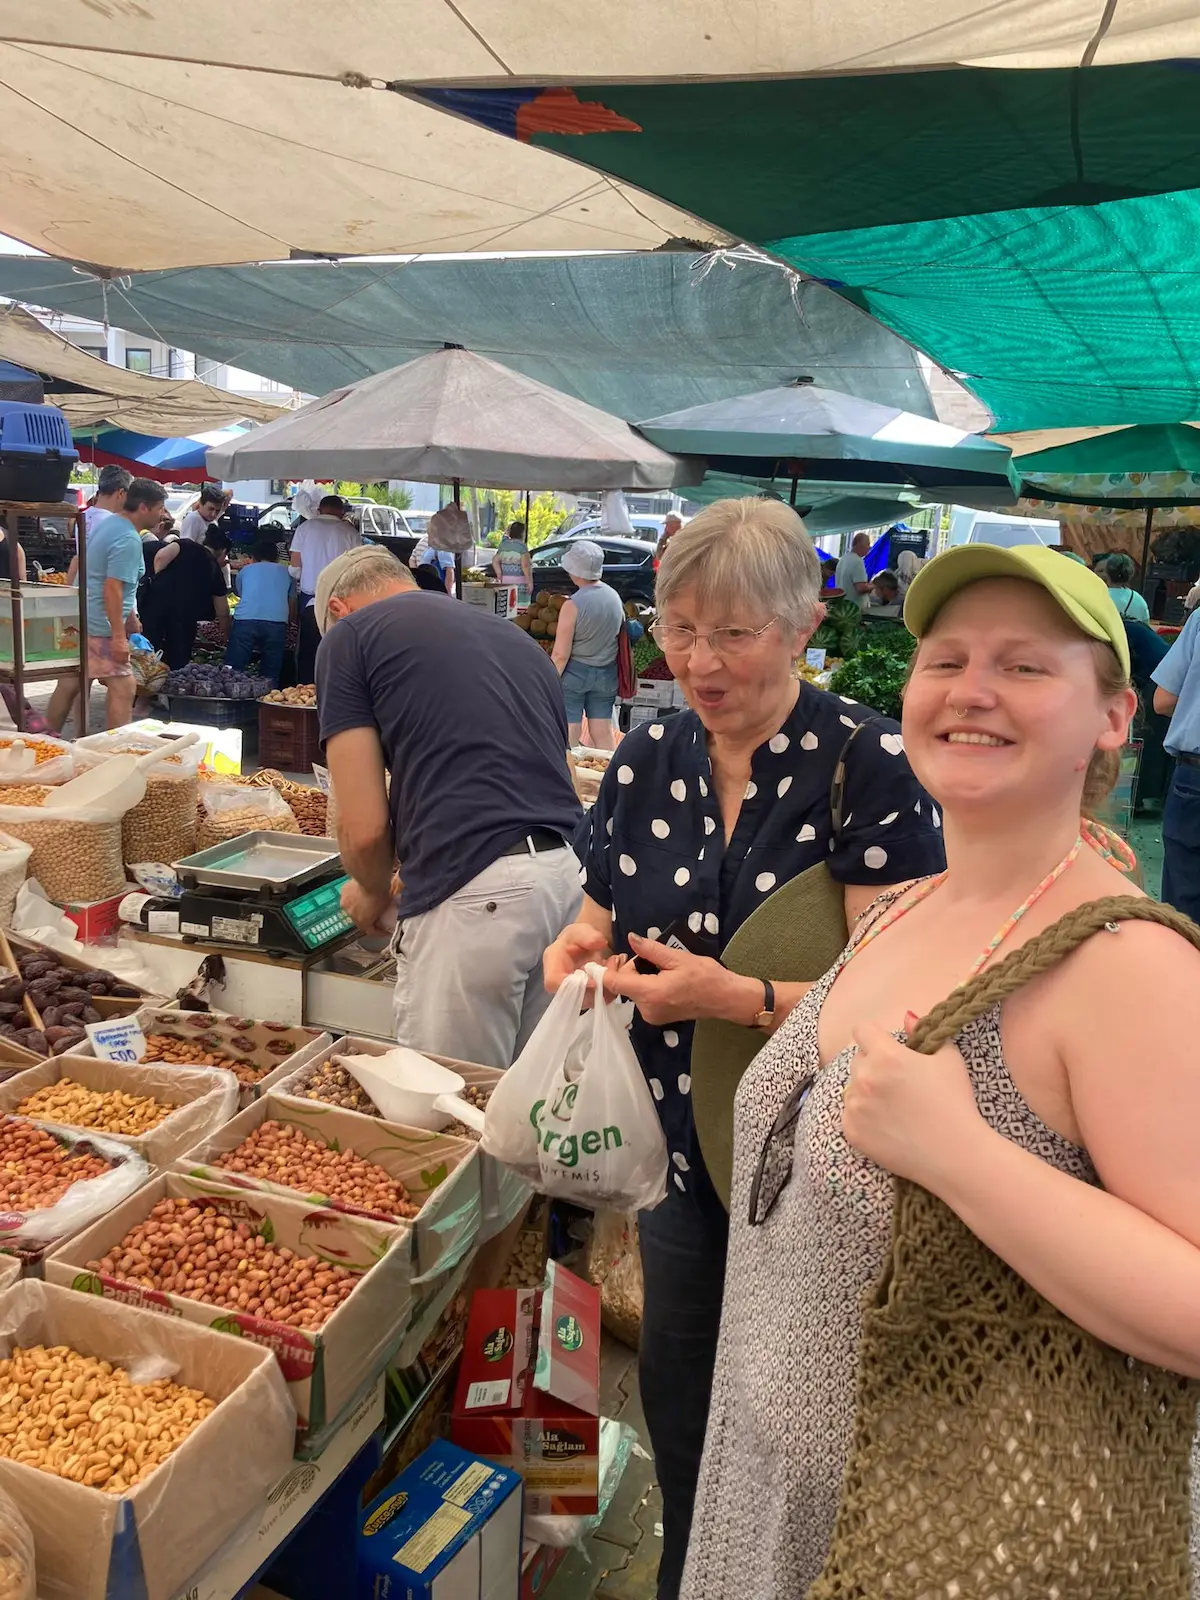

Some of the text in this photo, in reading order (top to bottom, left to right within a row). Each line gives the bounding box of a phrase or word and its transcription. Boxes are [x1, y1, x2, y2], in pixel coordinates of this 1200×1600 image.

[109, 1049, 137, 1062] 500
[536, 1431, 560, 1442] Ala
[542, 1441, 586, 1453] Sağlam
